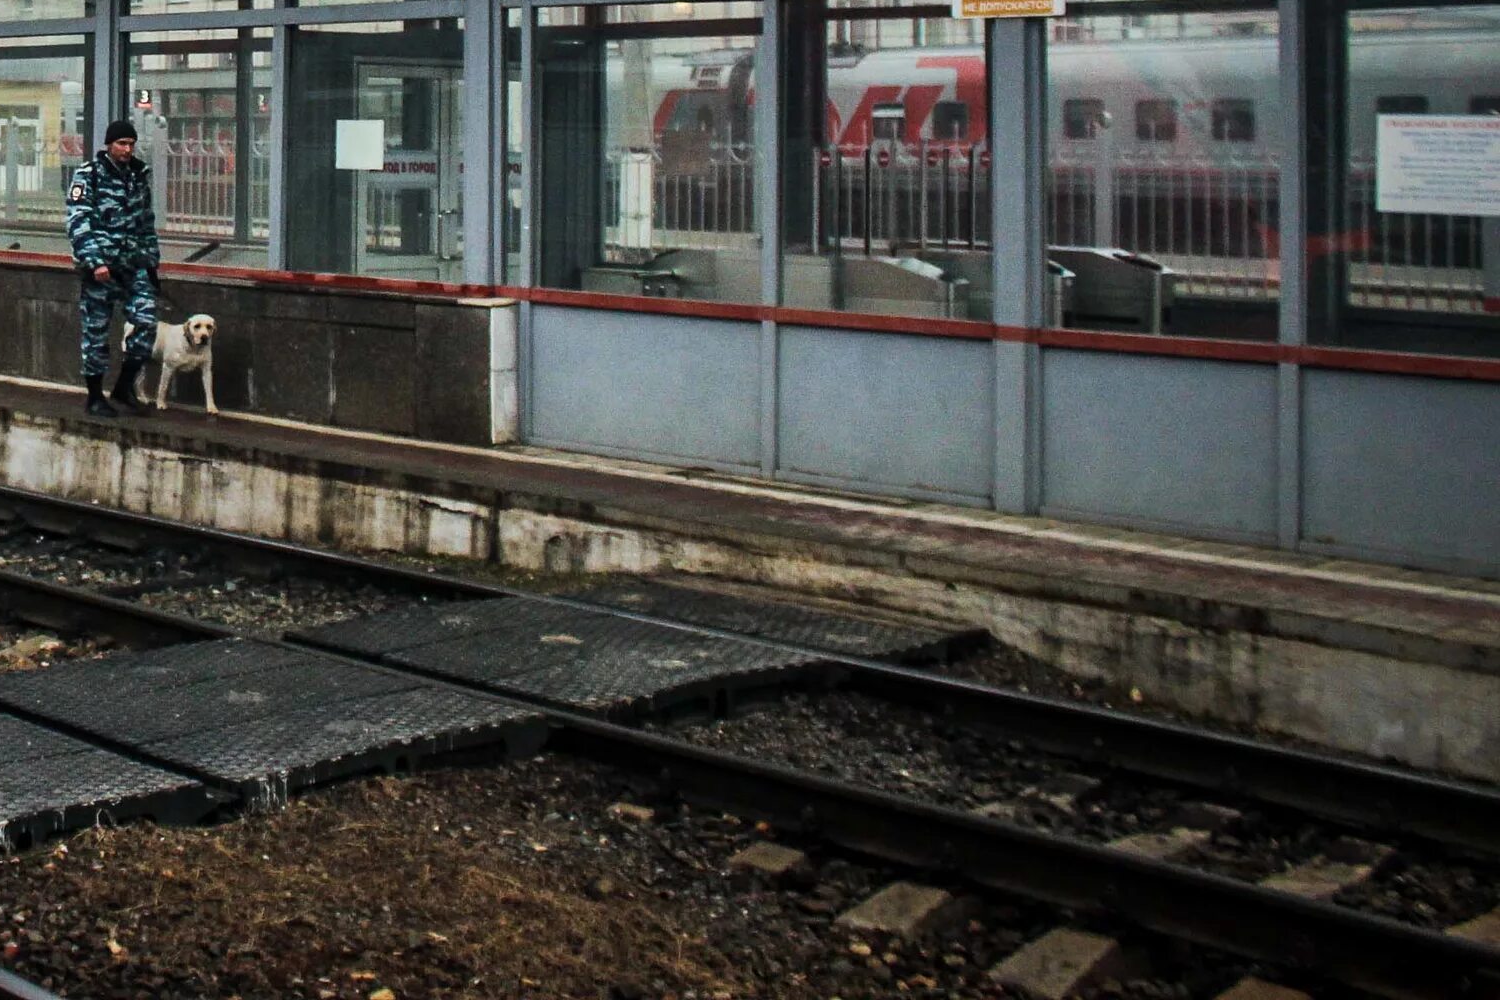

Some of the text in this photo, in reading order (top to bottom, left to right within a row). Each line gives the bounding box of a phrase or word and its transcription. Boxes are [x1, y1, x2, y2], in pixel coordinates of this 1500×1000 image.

[964, 2, 977, 12] НЕ
[140, 90, 150, 103] 3
[408, 162, 436, 174] ГОРОД
